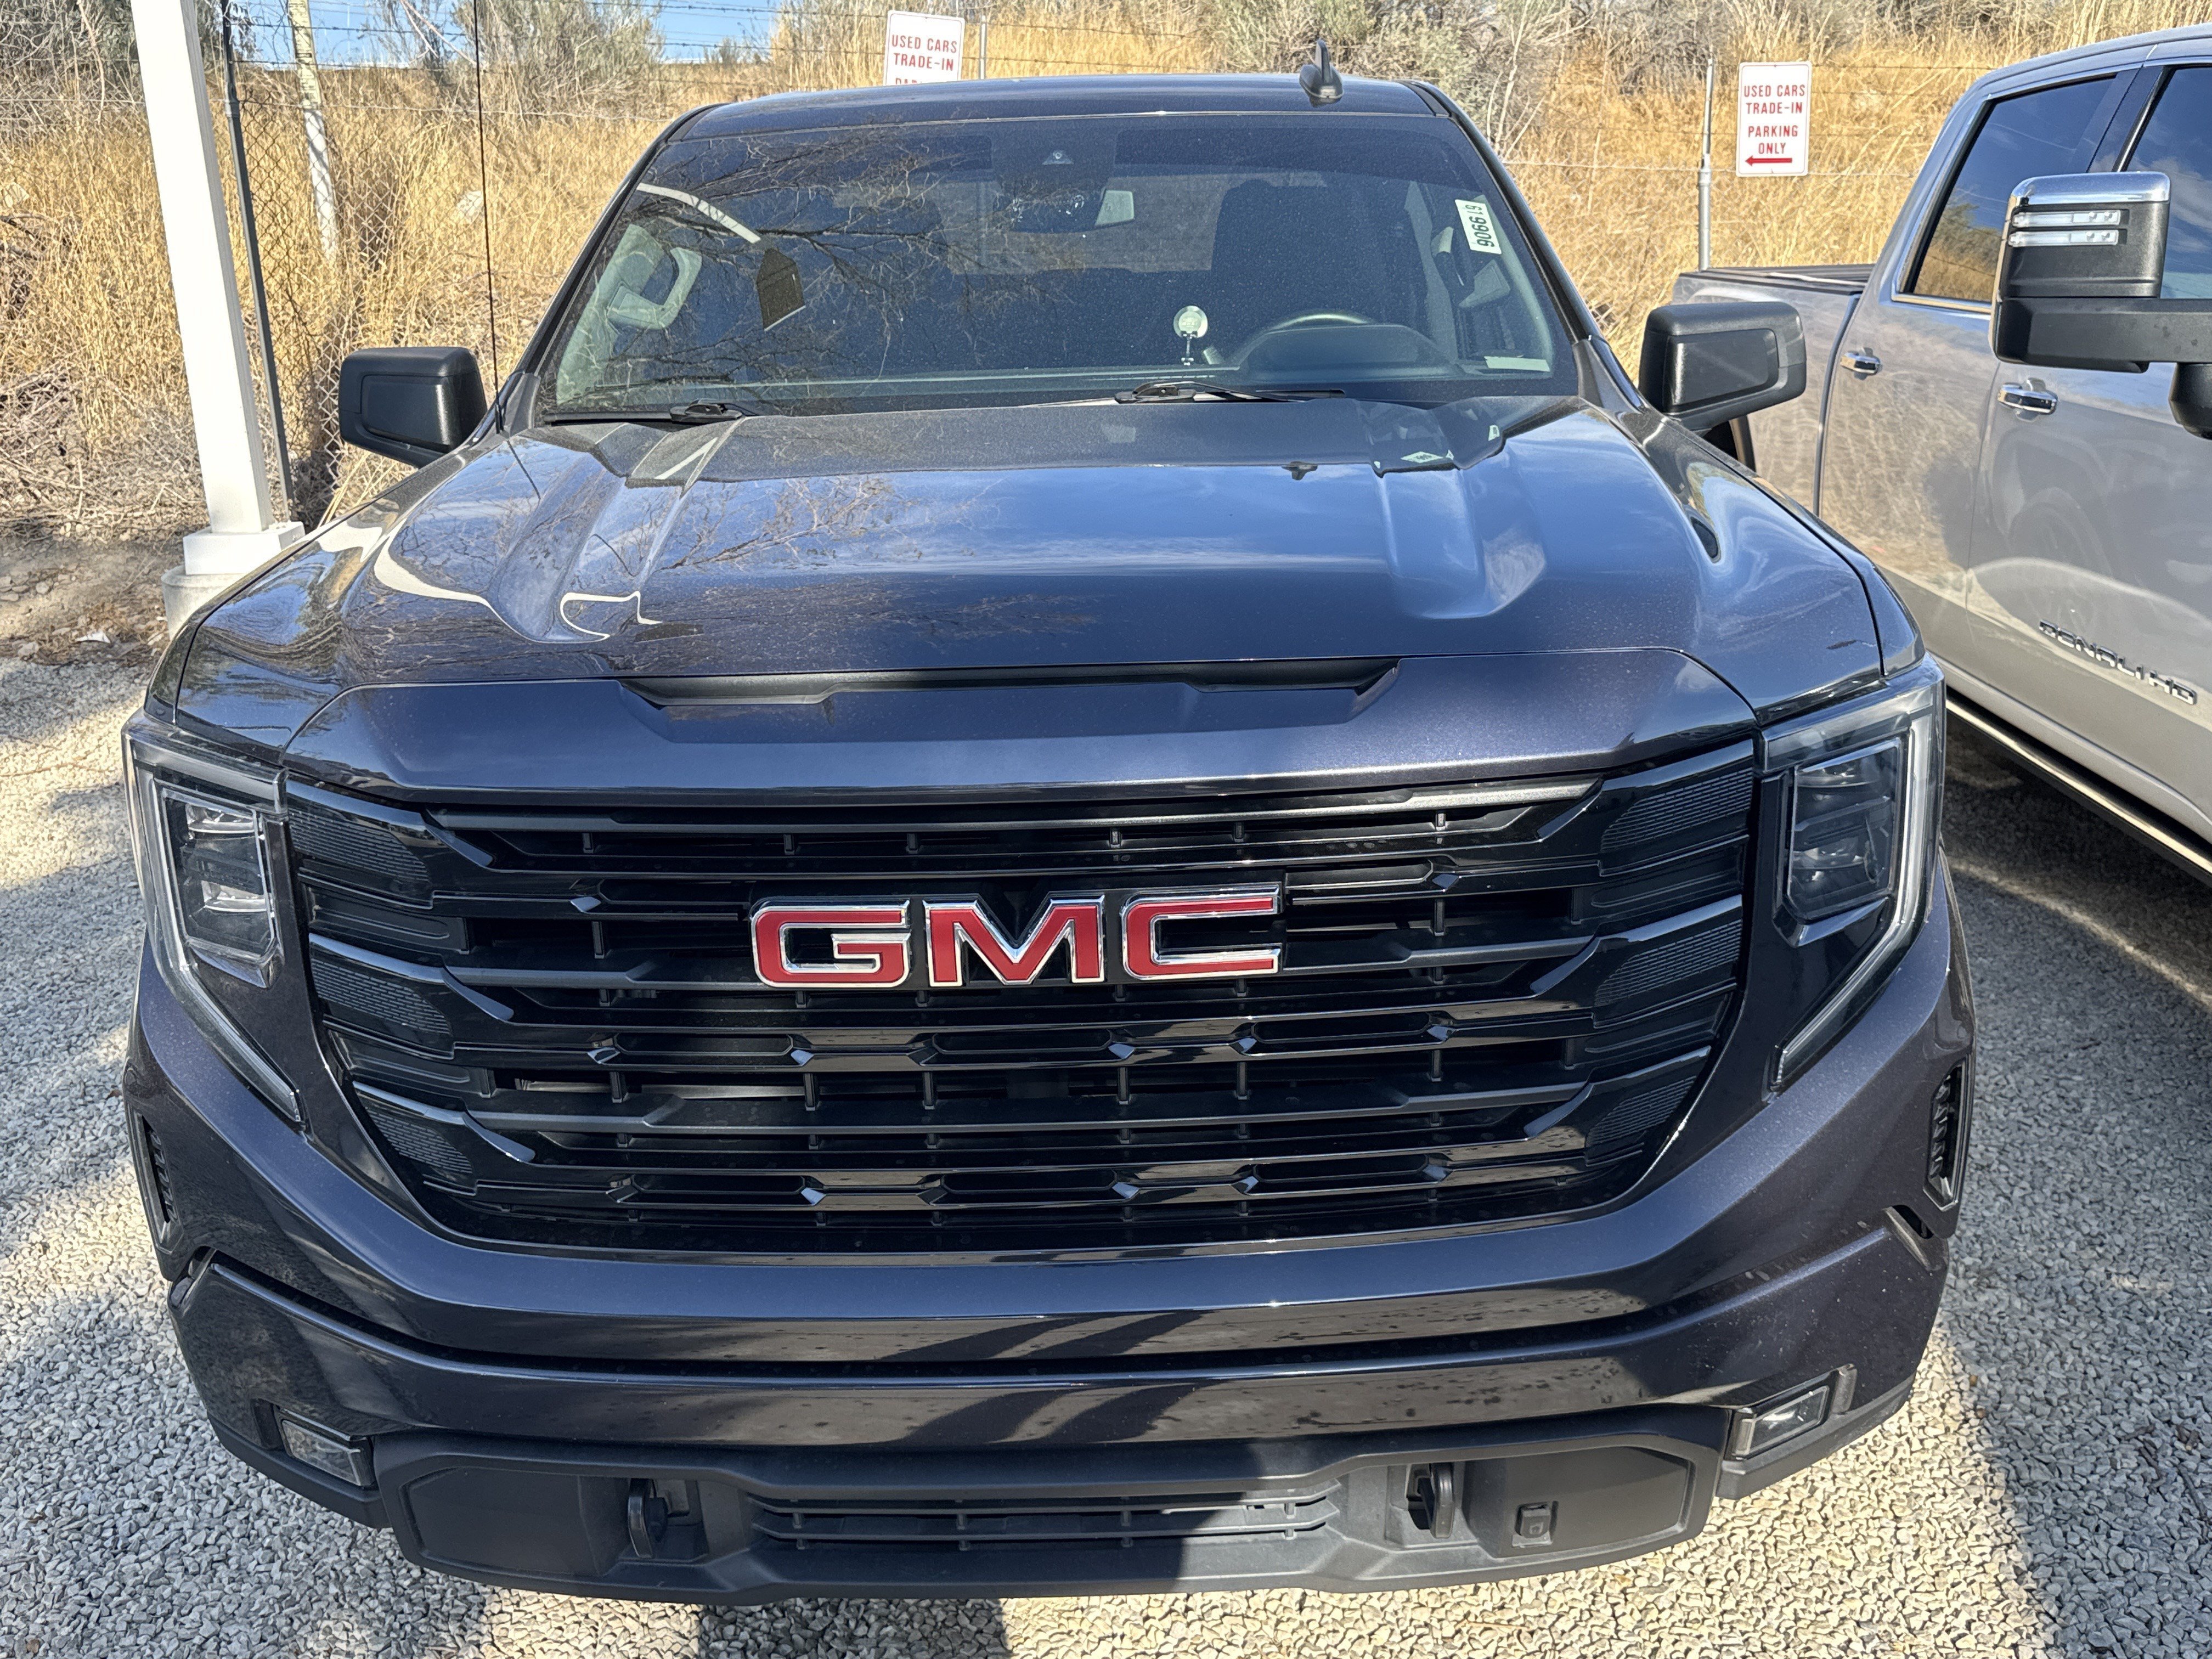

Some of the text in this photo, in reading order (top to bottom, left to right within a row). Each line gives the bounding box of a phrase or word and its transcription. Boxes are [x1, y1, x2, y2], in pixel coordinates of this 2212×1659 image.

[891, 34, 957, 54] USED CARS
[893, 52, 953, 71] TRADE-IN
[1743, 84, 1805, 98] USED CARS
[1746, 101, 1803, 115] TRADE-IN
[1747, 125, 1798, 138] PARKING
[1758, 142, 1787, 155] ONLY
[2039, 619, 2198, 705] DENALI HD
[751, 884, 1282, 989] GMC
